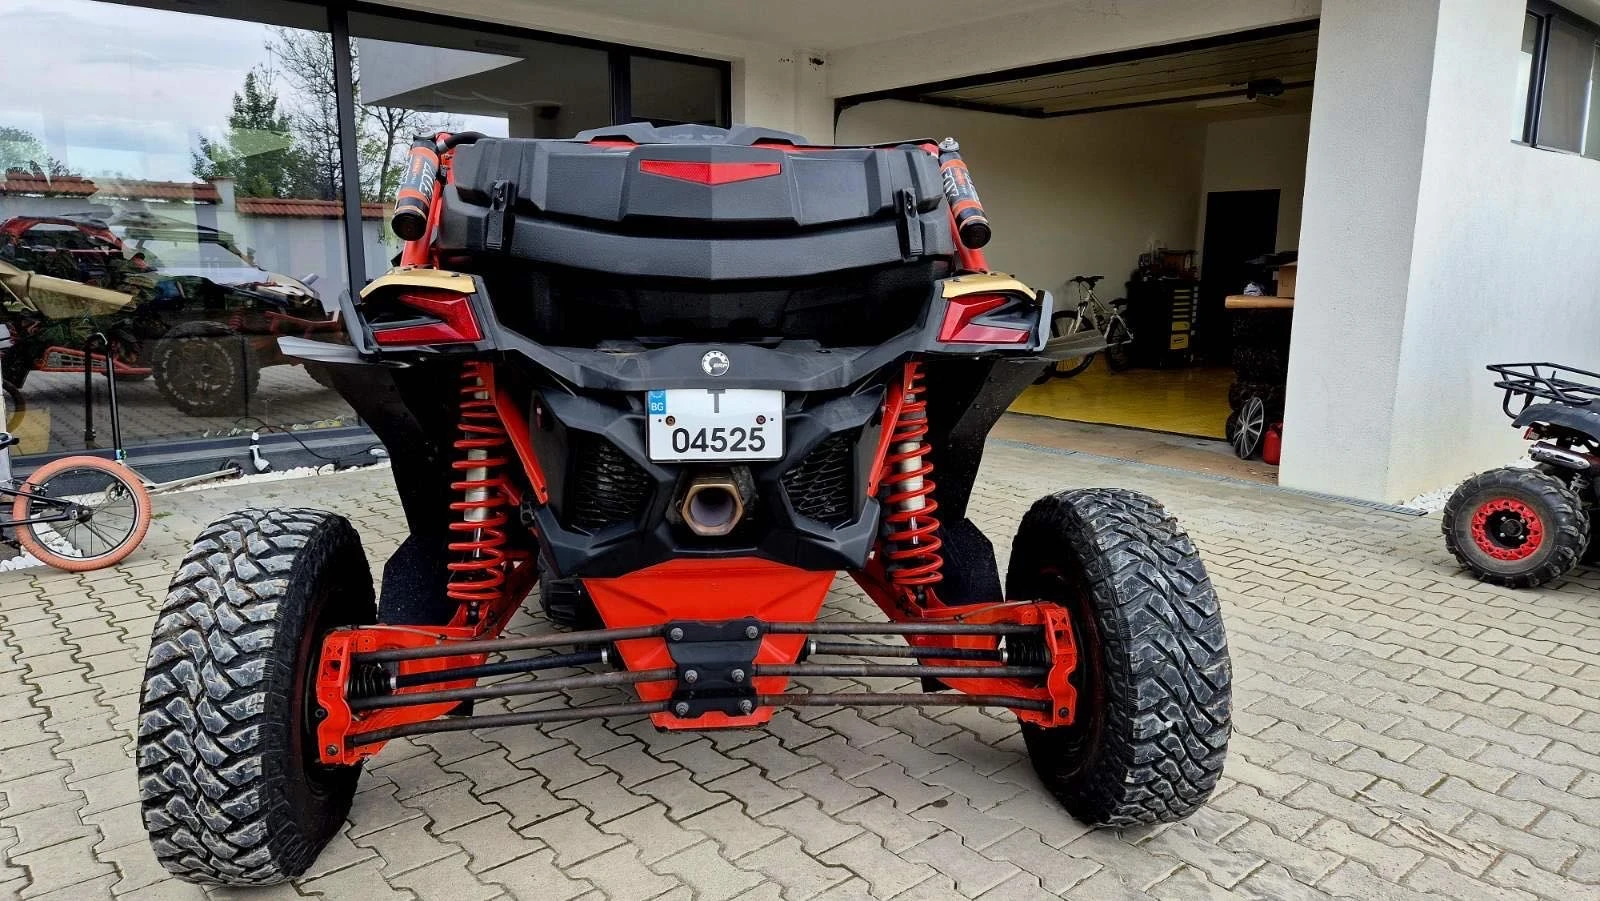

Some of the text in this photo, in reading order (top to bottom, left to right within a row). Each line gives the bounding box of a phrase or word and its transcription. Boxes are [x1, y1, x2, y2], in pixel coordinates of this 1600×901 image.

[651, 402, 664, 411] BG
[707, 388, 726, 413] T
[672, 427, 766, 453] 04525
